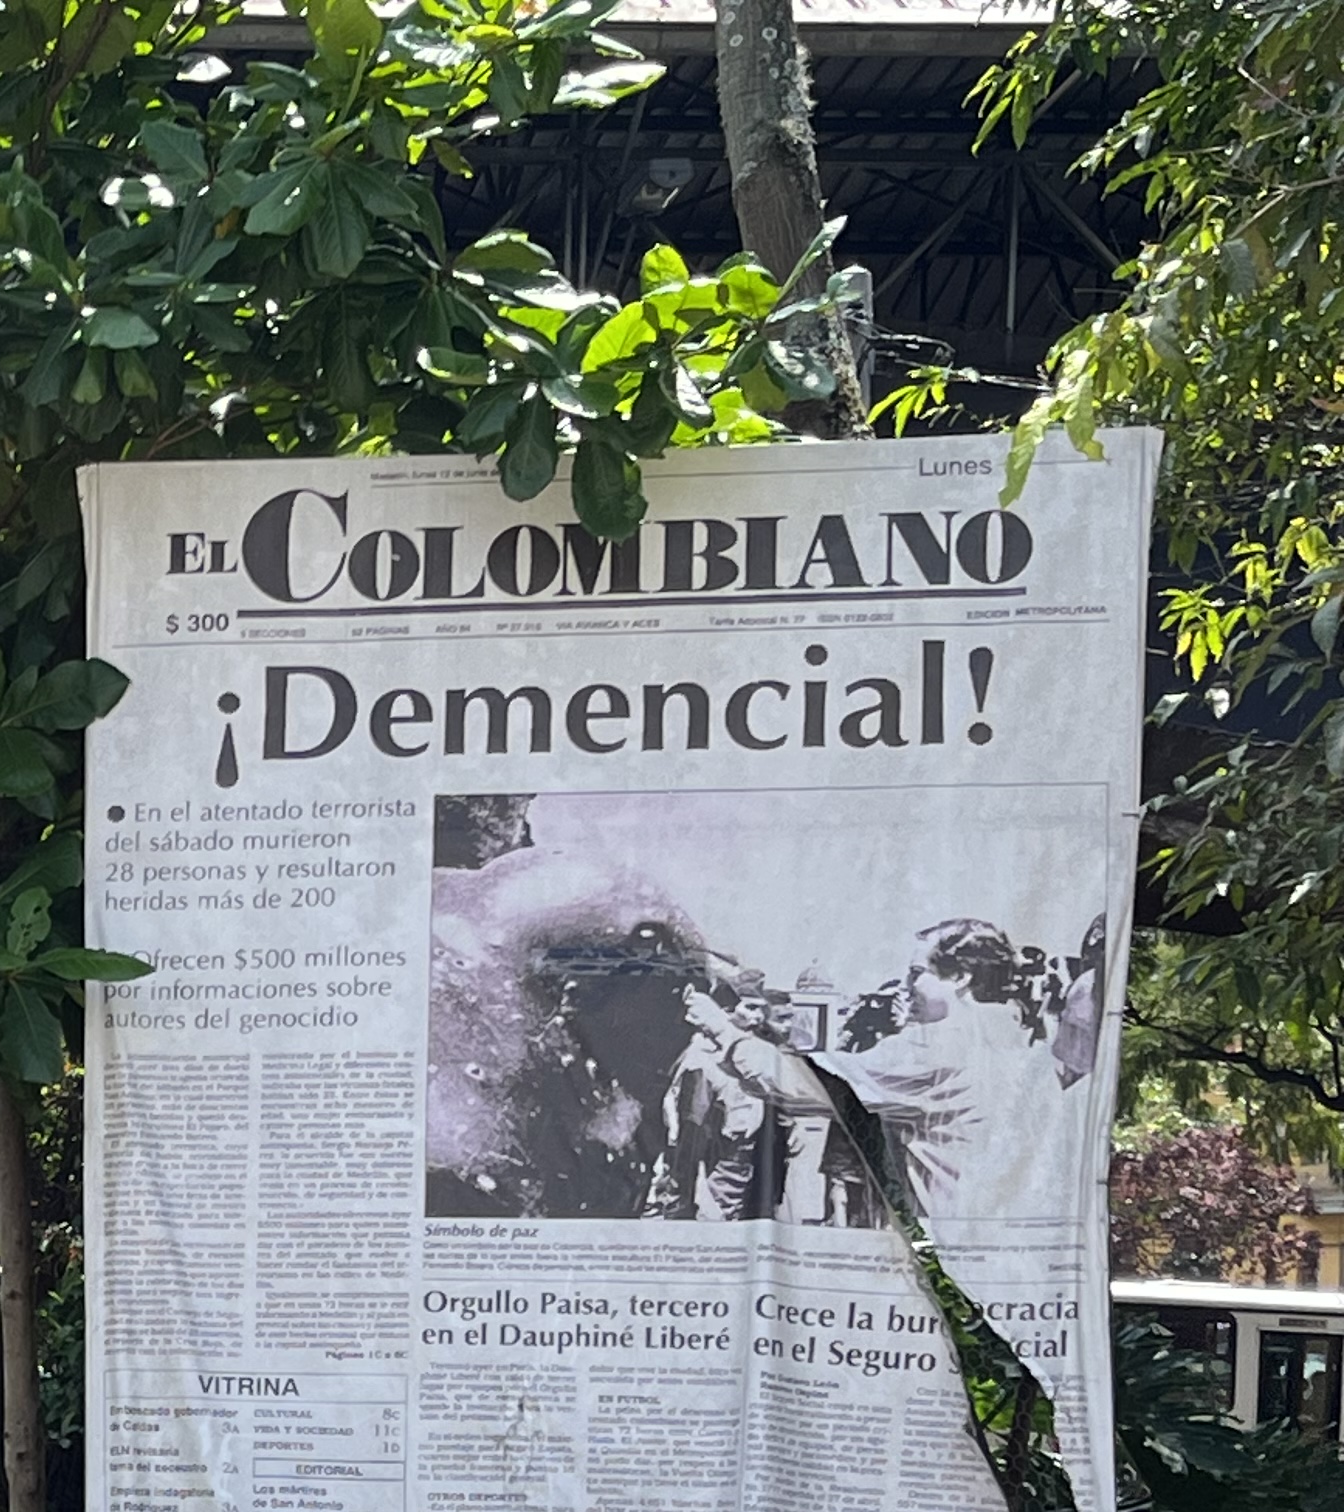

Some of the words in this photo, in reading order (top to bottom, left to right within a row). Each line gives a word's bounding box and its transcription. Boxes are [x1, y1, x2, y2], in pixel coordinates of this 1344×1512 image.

[918, 456, 993, 478] Lunes
[165, 531, 238, 576] EL
[242, 489, 1034, 603] COLOMBIANO
[165, 614, 180, 635] $
[187, 613, 230, 634] 300
[215, 639, 994, 789] ¡Demencial!
[134, 802, 162, 823] En
[170, 800, 191, 822] el
[199, 798, 303, 822] atentado
[310, 798, 417, 819] terrorista
[104, 830, 142, 853] del
[149, 829, 234, 852] sábado
[242, 828, 351, 850] murieron
[105, 862, 135, 883] 28
[142, 861, 247, 886] personas
[255, 861, 269, 883] y
[277, 857, 396, 879] resultaron
[105, 889, 189, 911] heridas
[197, 889, 245, 911] más
[252, 887, 283, 909] de
[290, 887, 336, 908] 200
[133, 949, 225, 971] Ofrecen
[233, 948, 296, 971] $500
[304, 944, 407, 968] millones
[103, 984, 142, 1004] por
[150, 977, 318, 1001] informaciones
[326, 975, 393, 997] sobre
[104, 1010, 186, 1030] autores
[194, 1007, 231, 1030] del
[239, 1006, 359, 1034] genocidio
[424, 1222, 485, 1240] Símbolo
[490, 1223, 508, 1240] de
[511, 1225, 539, 1241] paz
[423, 1289, 529, 1321] Orgullo
[540, 1291, 619, 1321] Paisa,
[629, 1294, 730, 1319] tercero
[755, 1293, 836, 1329] Crece
[847, 1302, 874, 1332] la
[421, 1327, 454, 1346] en
[464, 1323, 488, 1346] el
[499, 1323, 635, 1354] Dauphiné
[645, 1326, 731, 1352] Liberé
[753, 1336, 784, 1358] en
[791, 1336, 816, 1364] el
[827, 1340, 937, 1377] Seguro
[198, 1374, 300, 1398] VITRINA
[295, 1464, 364, 1477] EDITORIAL
[297, 1500, 344, 1512] Antonio
